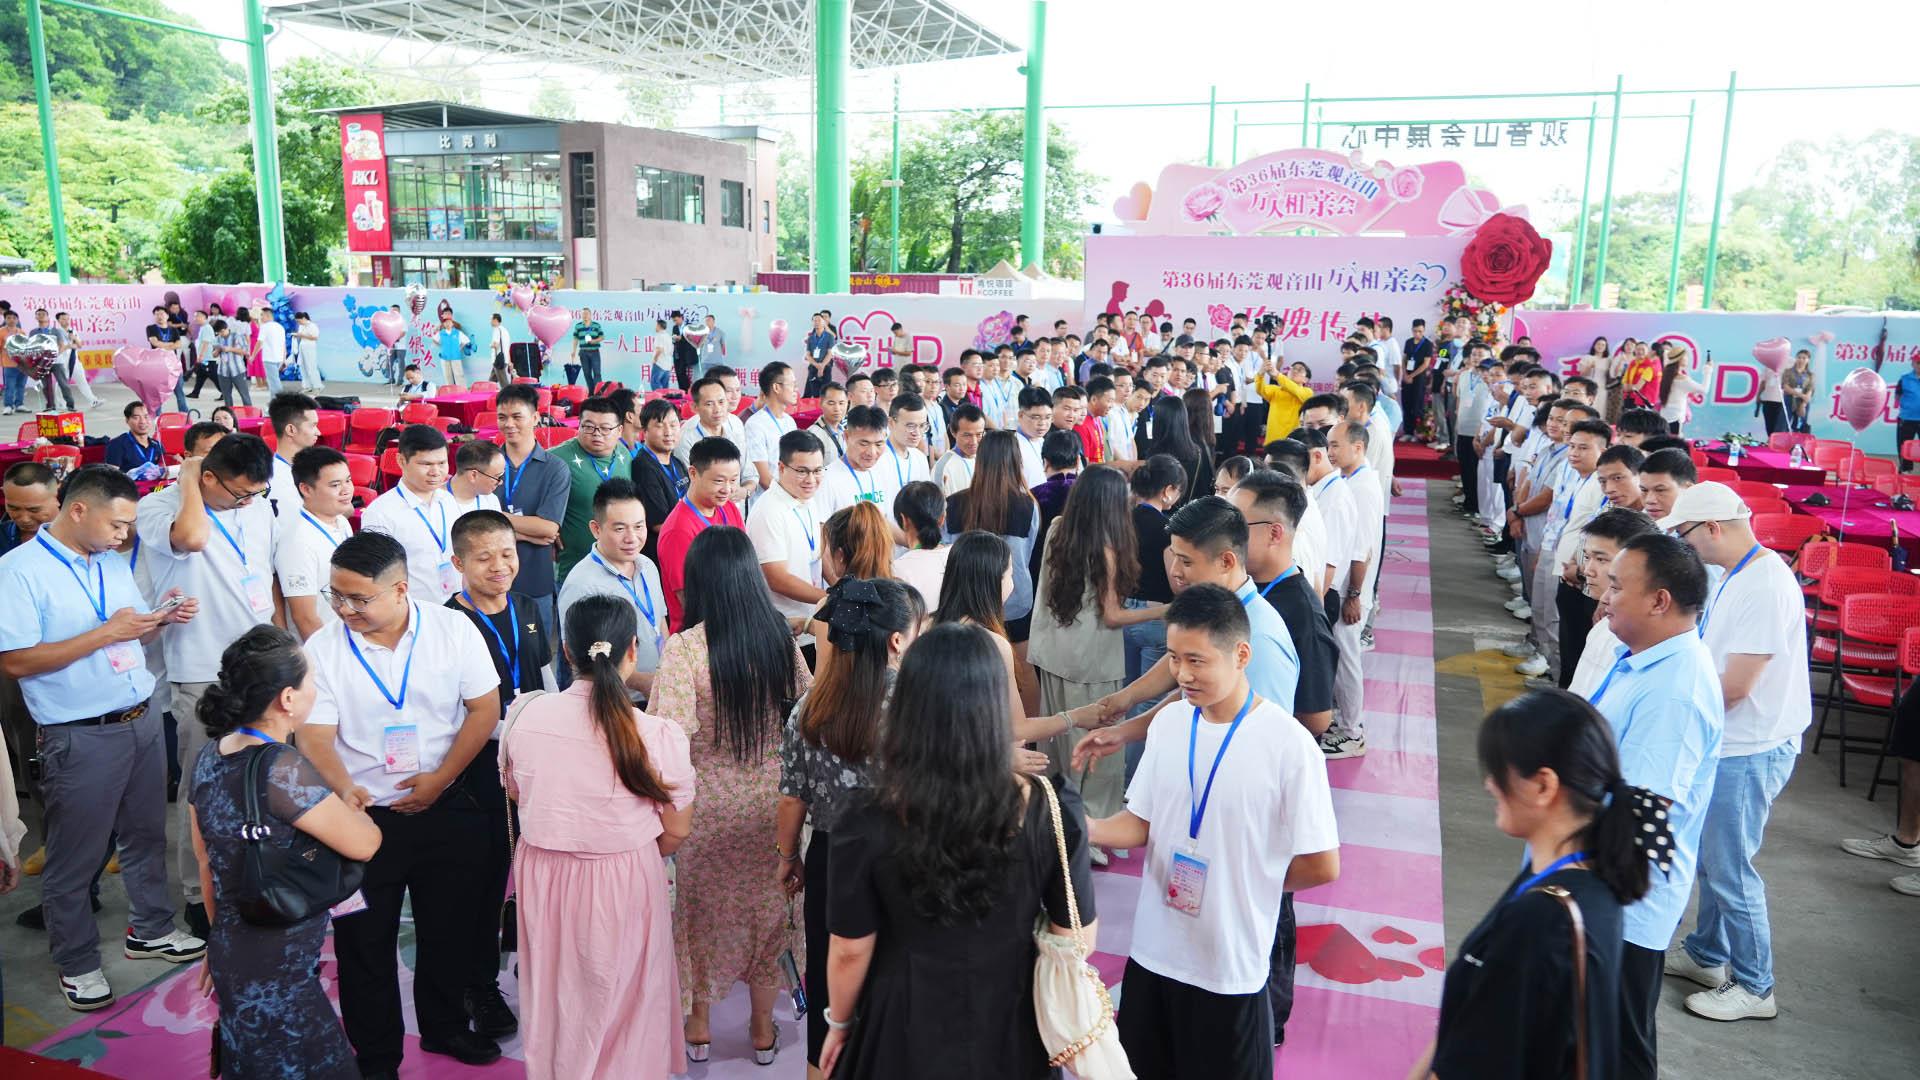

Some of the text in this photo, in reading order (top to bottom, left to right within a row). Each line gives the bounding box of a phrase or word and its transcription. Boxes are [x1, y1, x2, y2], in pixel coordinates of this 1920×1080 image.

[439, 133, 497, 149] 比克利
[351, 170, 379, 186] BKL
[1229, 160, 1379, 200] 第36届东莞观音山
[1251, 188, 1355, 218] 万人相亲会
